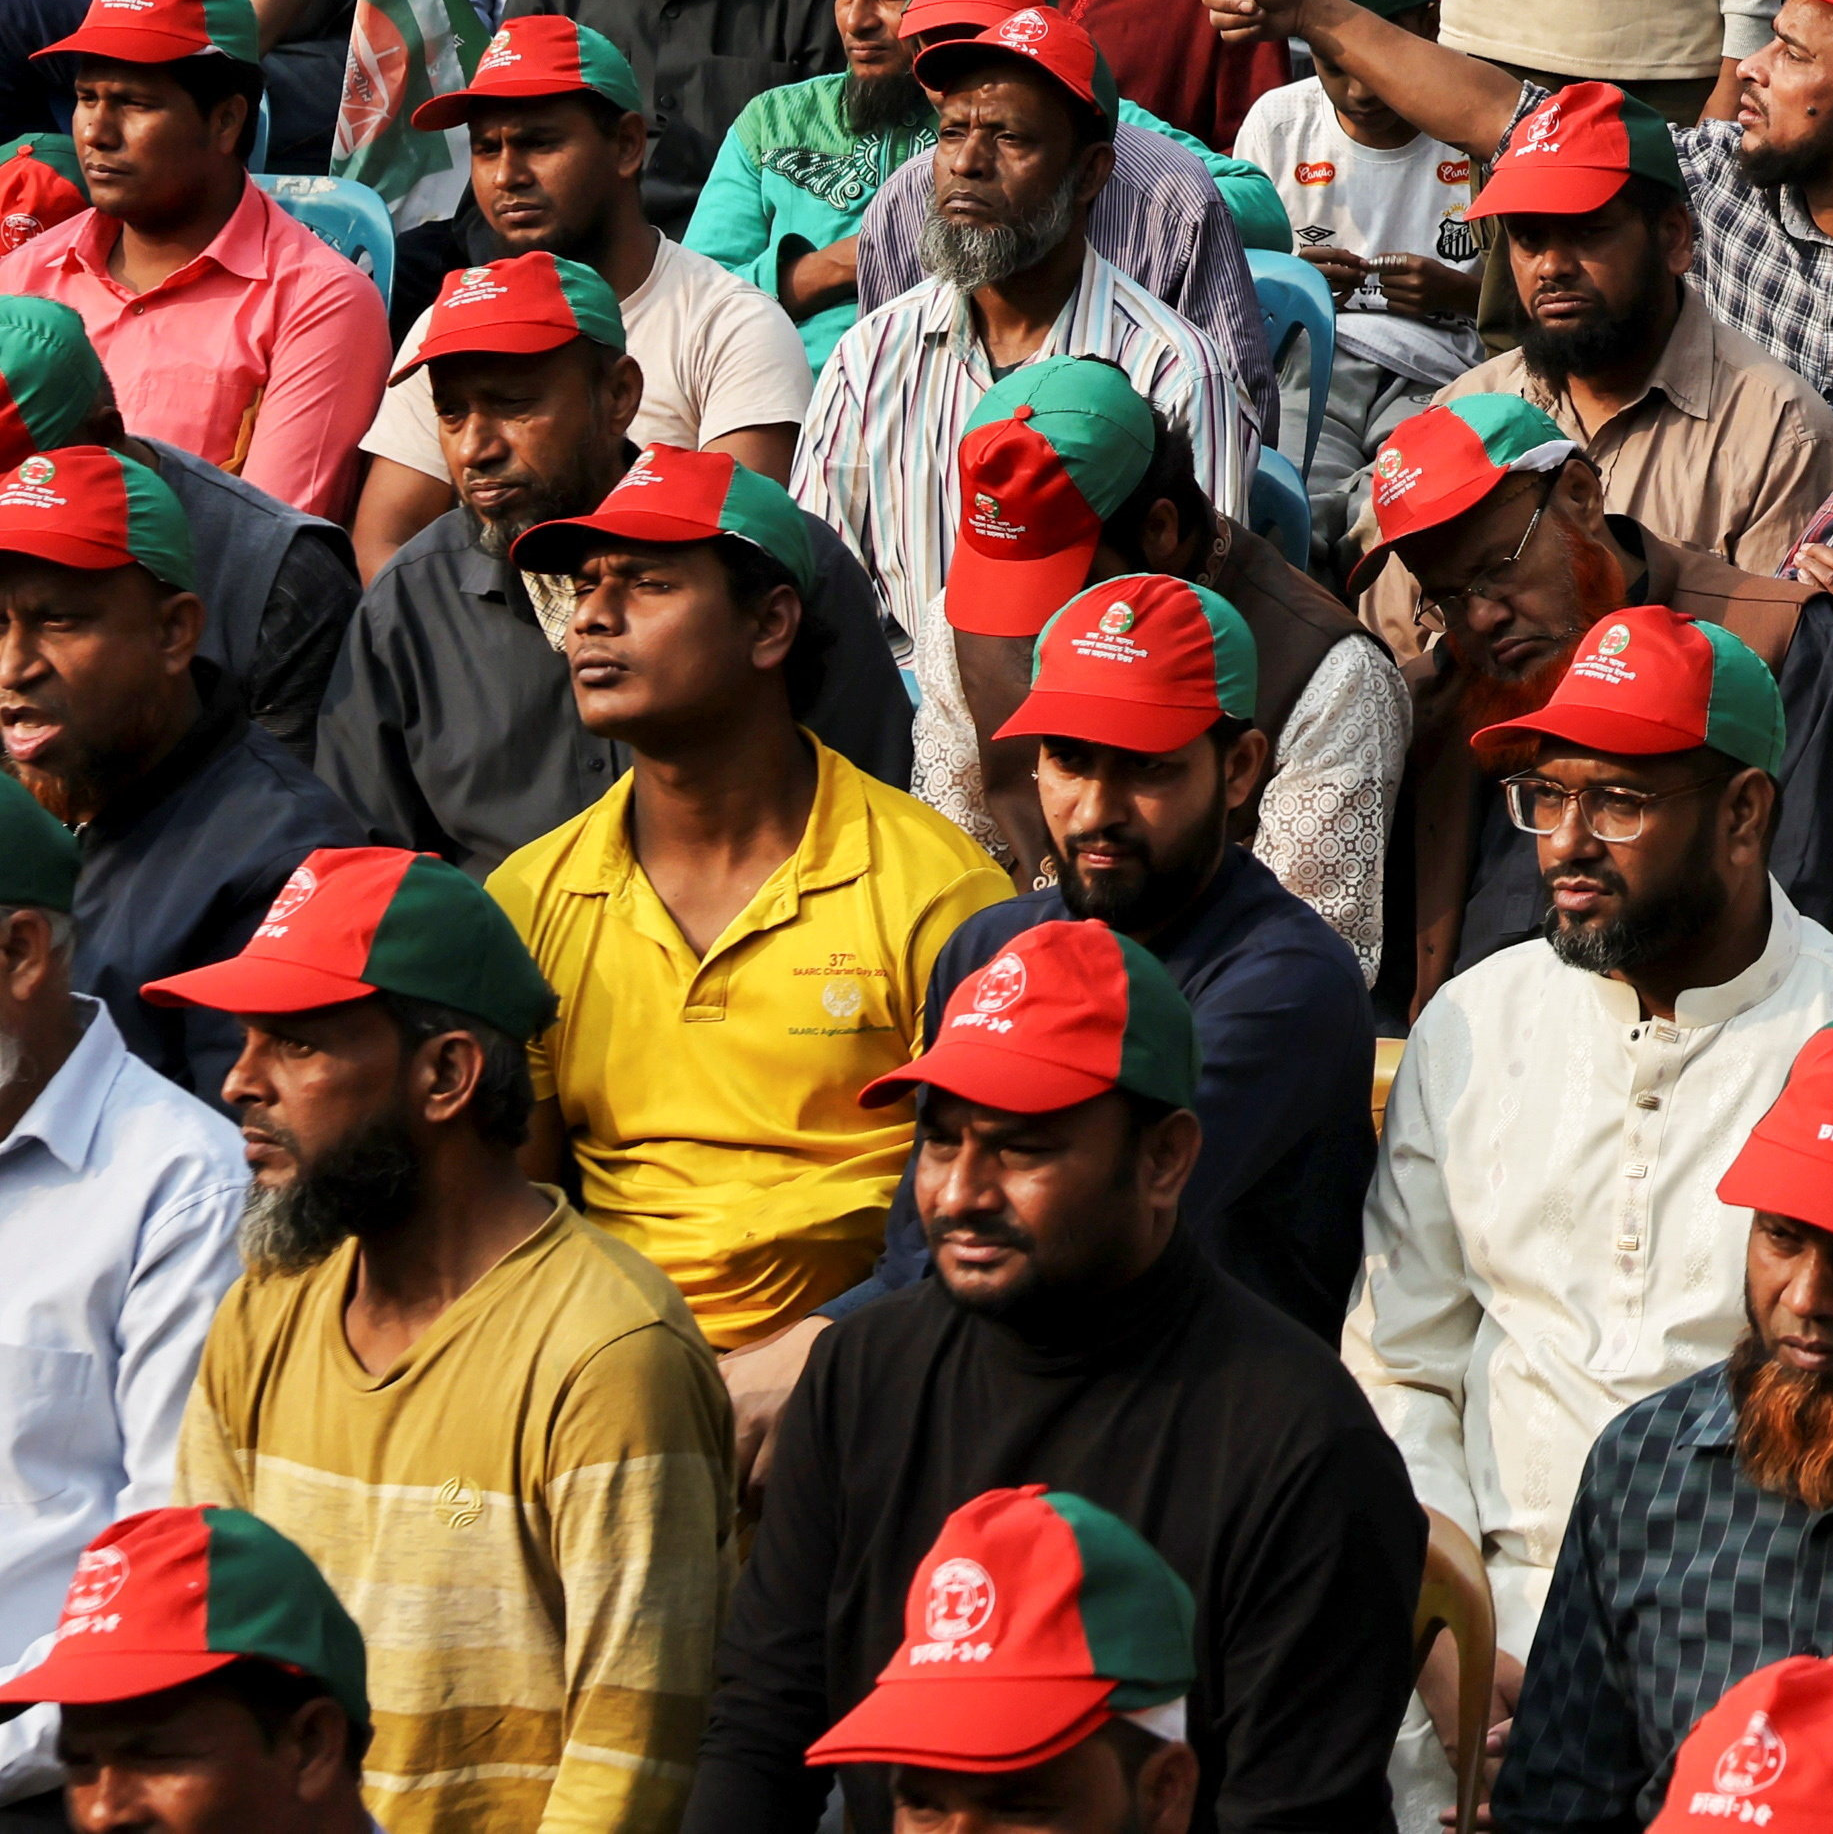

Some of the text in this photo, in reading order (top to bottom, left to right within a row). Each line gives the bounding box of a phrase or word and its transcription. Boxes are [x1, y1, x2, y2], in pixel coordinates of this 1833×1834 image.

[1294, 165, 1329, 184] Canção
[829, 952, 856, 967] 37th
[793, 966, 823, 977] SAARC
[824, 967, 854, 977] Charter
[856, 967, 873, 977] Day
[951, 1013, 1012, 1033] ঢাকা-১৫
